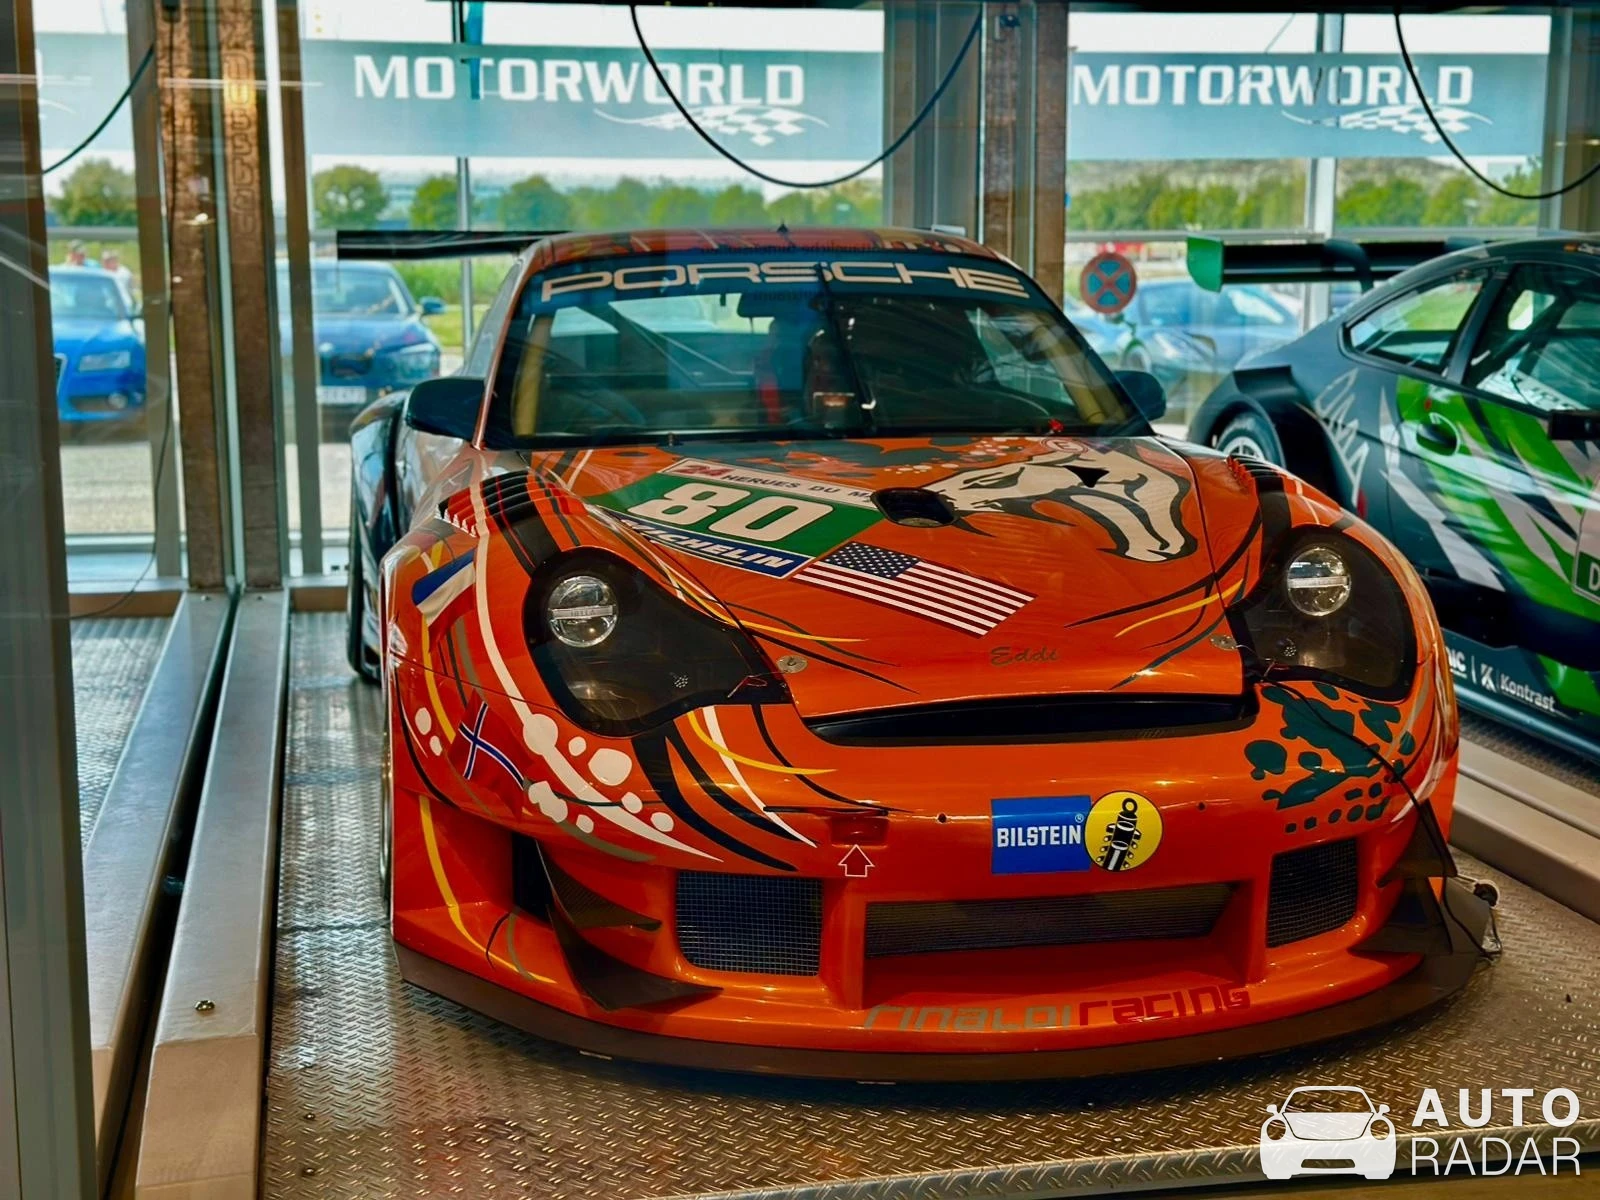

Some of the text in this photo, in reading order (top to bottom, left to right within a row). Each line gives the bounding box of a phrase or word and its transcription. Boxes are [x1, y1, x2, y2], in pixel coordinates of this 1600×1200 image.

[1073, 64, 1473, 106] MOTORWORLD
[541, 261, 1031, 303] PORSCHE
[808, 485, 841, 493] DU
[627, 482, 834, 542] 80
[620, 519, 795, 568] MICHELIN
[1500, 673, 1556, 712] Kontrast
[997, 825, 1082, 848] BILSTEIN
